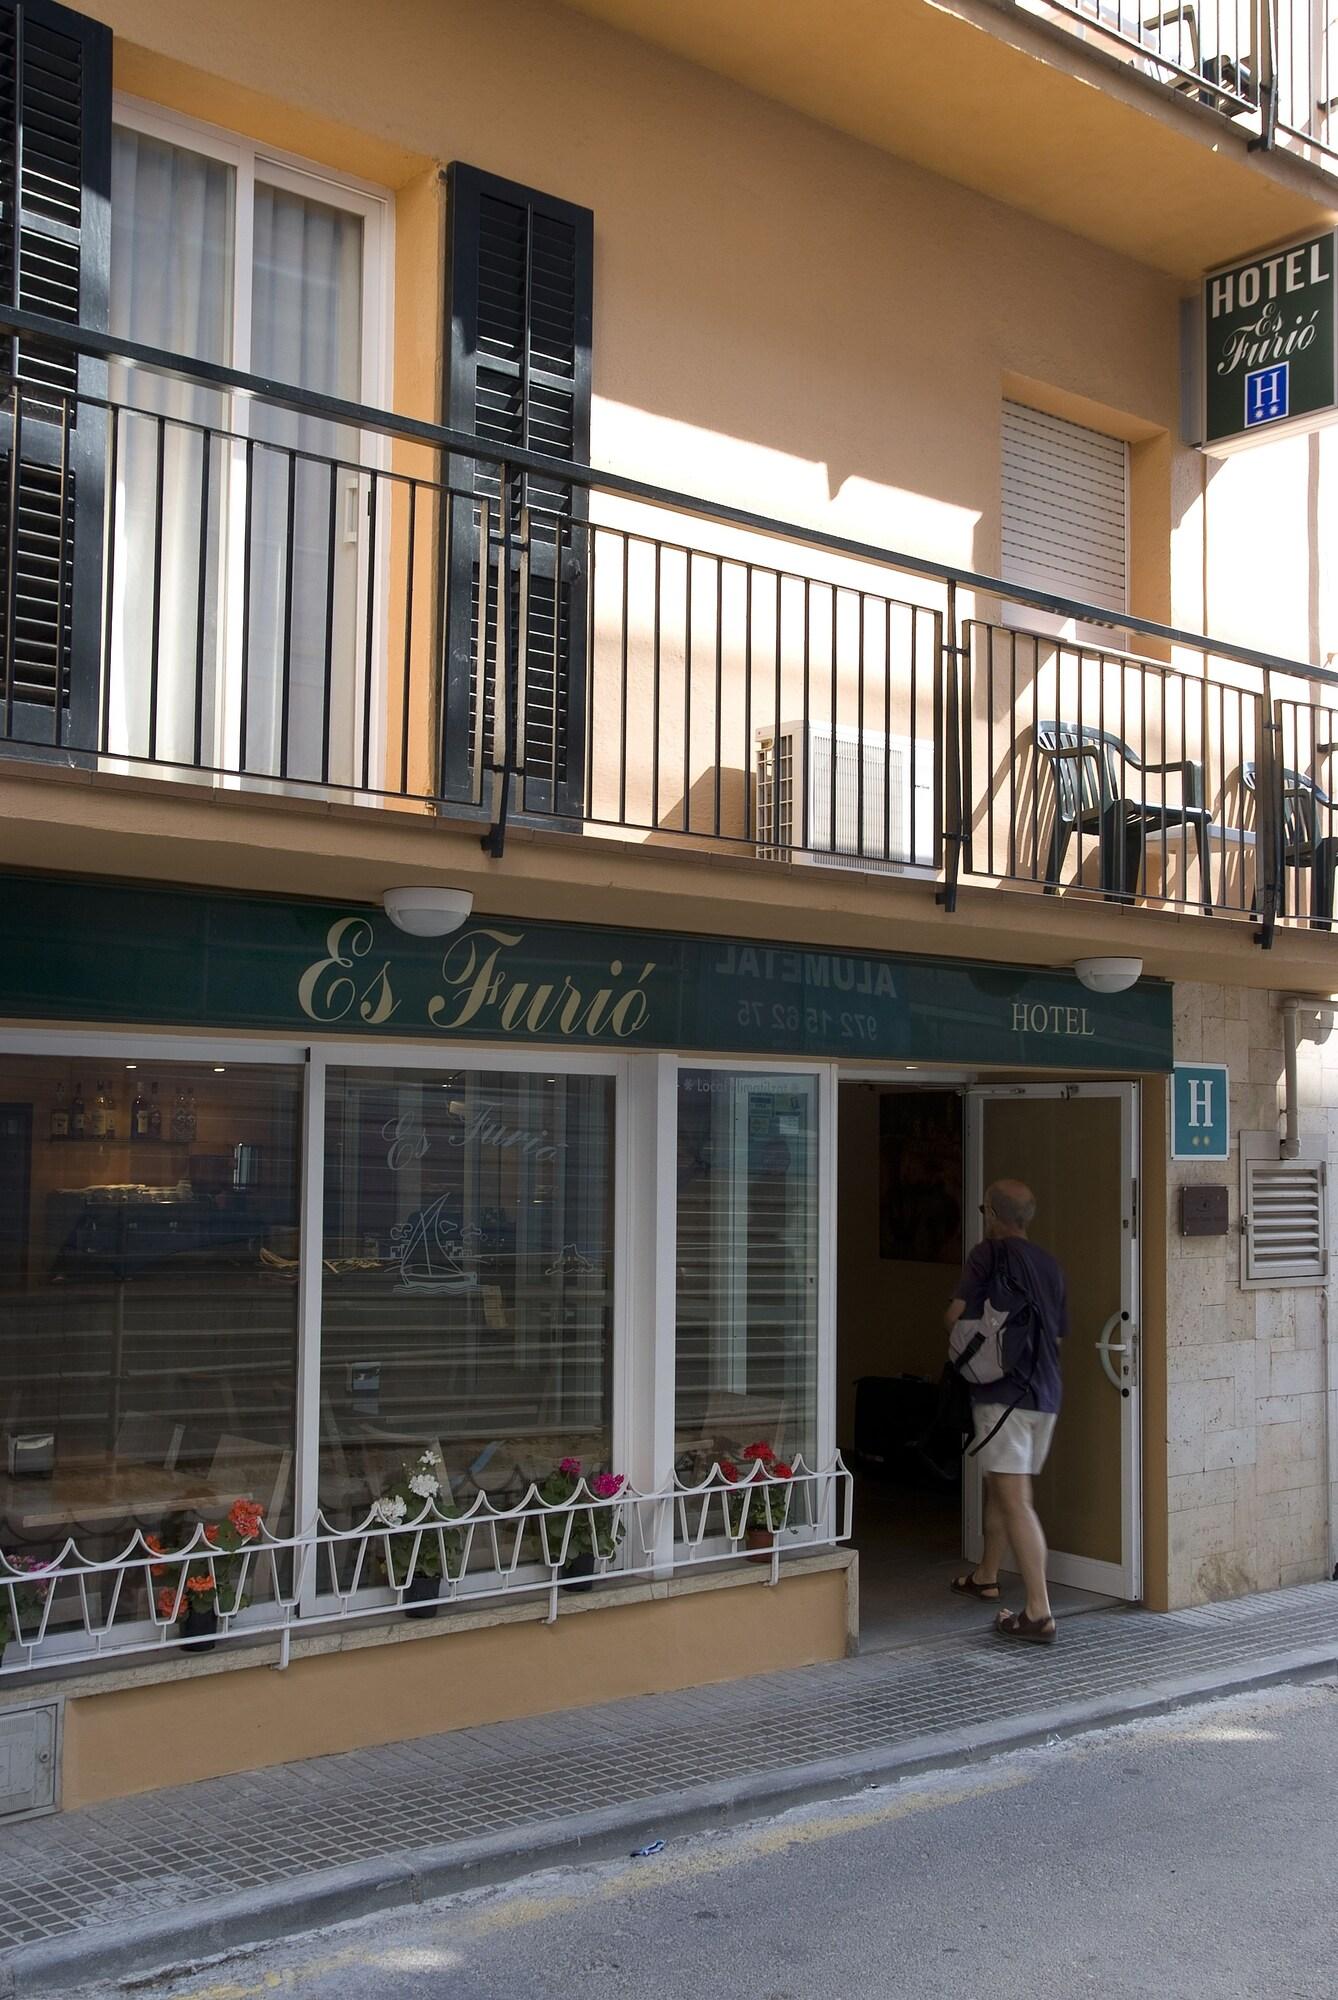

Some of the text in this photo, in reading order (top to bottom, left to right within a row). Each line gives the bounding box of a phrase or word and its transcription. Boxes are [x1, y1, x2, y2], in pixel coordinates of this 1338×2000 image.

[1212, 243, 1330, 318] HOTEL
[1217, 309, 1320, 376] Furió
[1255, 301, 1283, 337] Es
[1253, 370, 1281, 409] H
[298, 917, 656, 1037] Es Furió
[1010, 1003, 1096, 1036] HOTEL
[1187, 1079, 1214, 1128] H
[382, 1111, 432, 1171] Es
